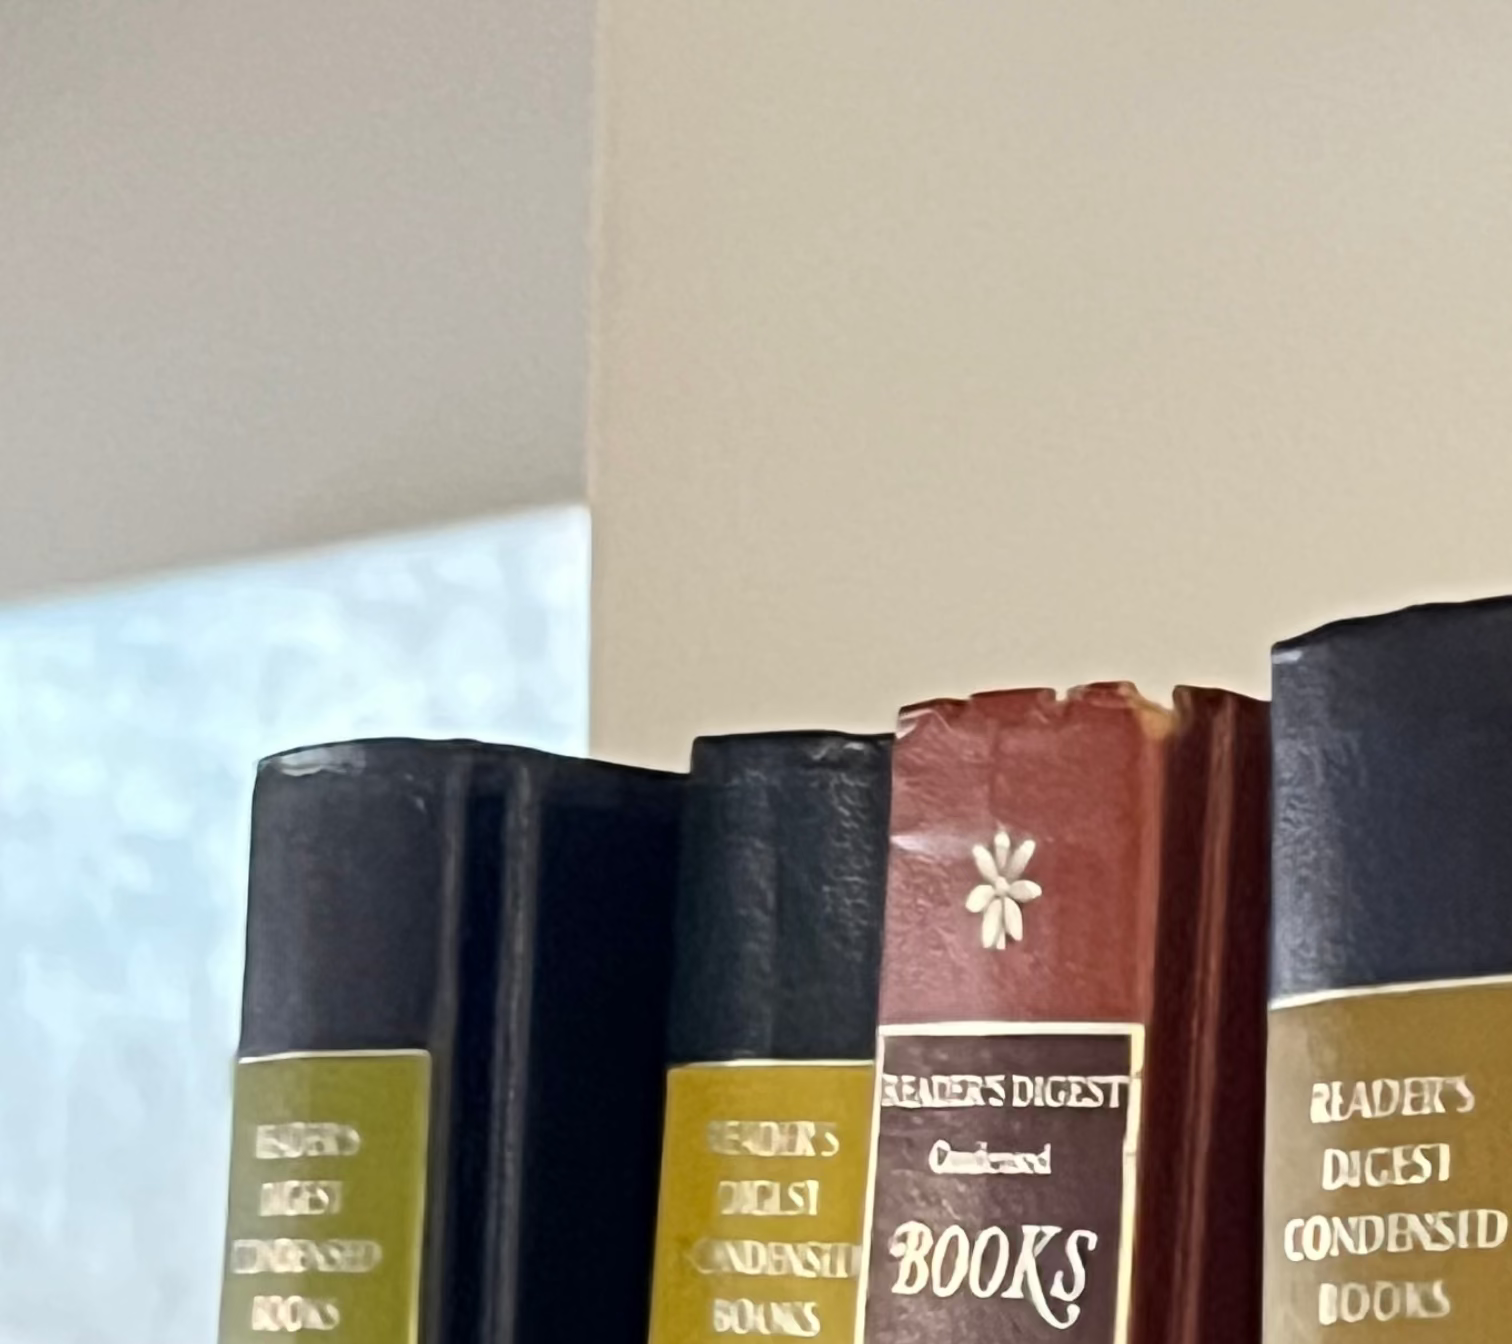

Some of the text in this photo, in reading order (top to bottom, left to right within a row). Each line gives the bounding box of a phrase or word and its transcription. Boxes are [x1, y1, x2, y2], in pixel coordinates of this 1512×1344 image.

[1012, 1075, 1130, 1109] DIGEST
[1322, 1143, 1450, 1190] DIGEST
[1284, 1209, 1508, 1262] CONDENSED
[889, 1221, 1098, 1329] BOOKS
[1318, 1279, 1450, 1325] BOOKS
